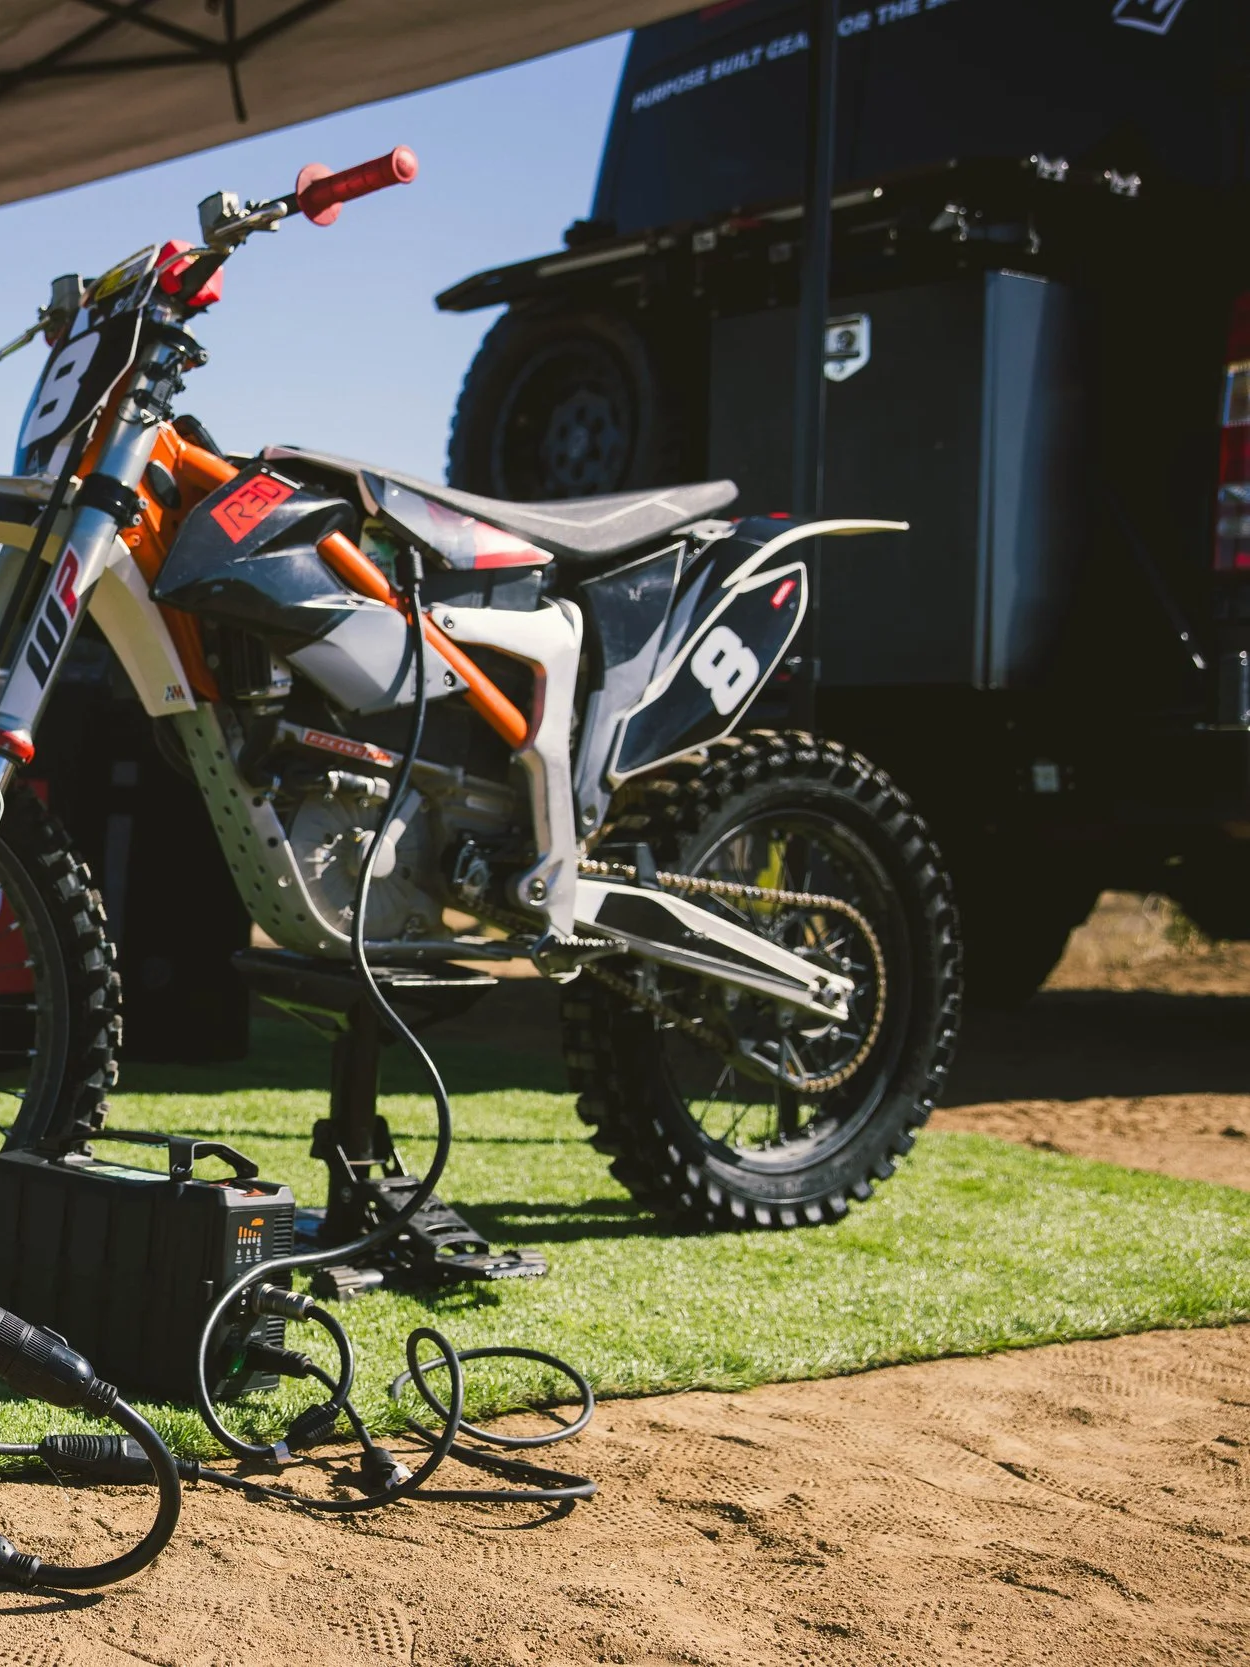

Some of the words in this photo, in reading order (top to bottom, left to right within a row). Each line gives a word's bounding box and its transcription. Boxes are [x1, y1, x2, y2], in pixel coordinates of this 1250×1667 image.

[631, 64, 708, 114] PURPOSE
[709, 46, 764, 82] BUILT
[765, 31, 809, 62] GEA
[836, 10, 872, 38] OR
[876, 0, 920, 26] THE
[20, 331, 100, 449] 8
[690, 625, 760, 716] 8
